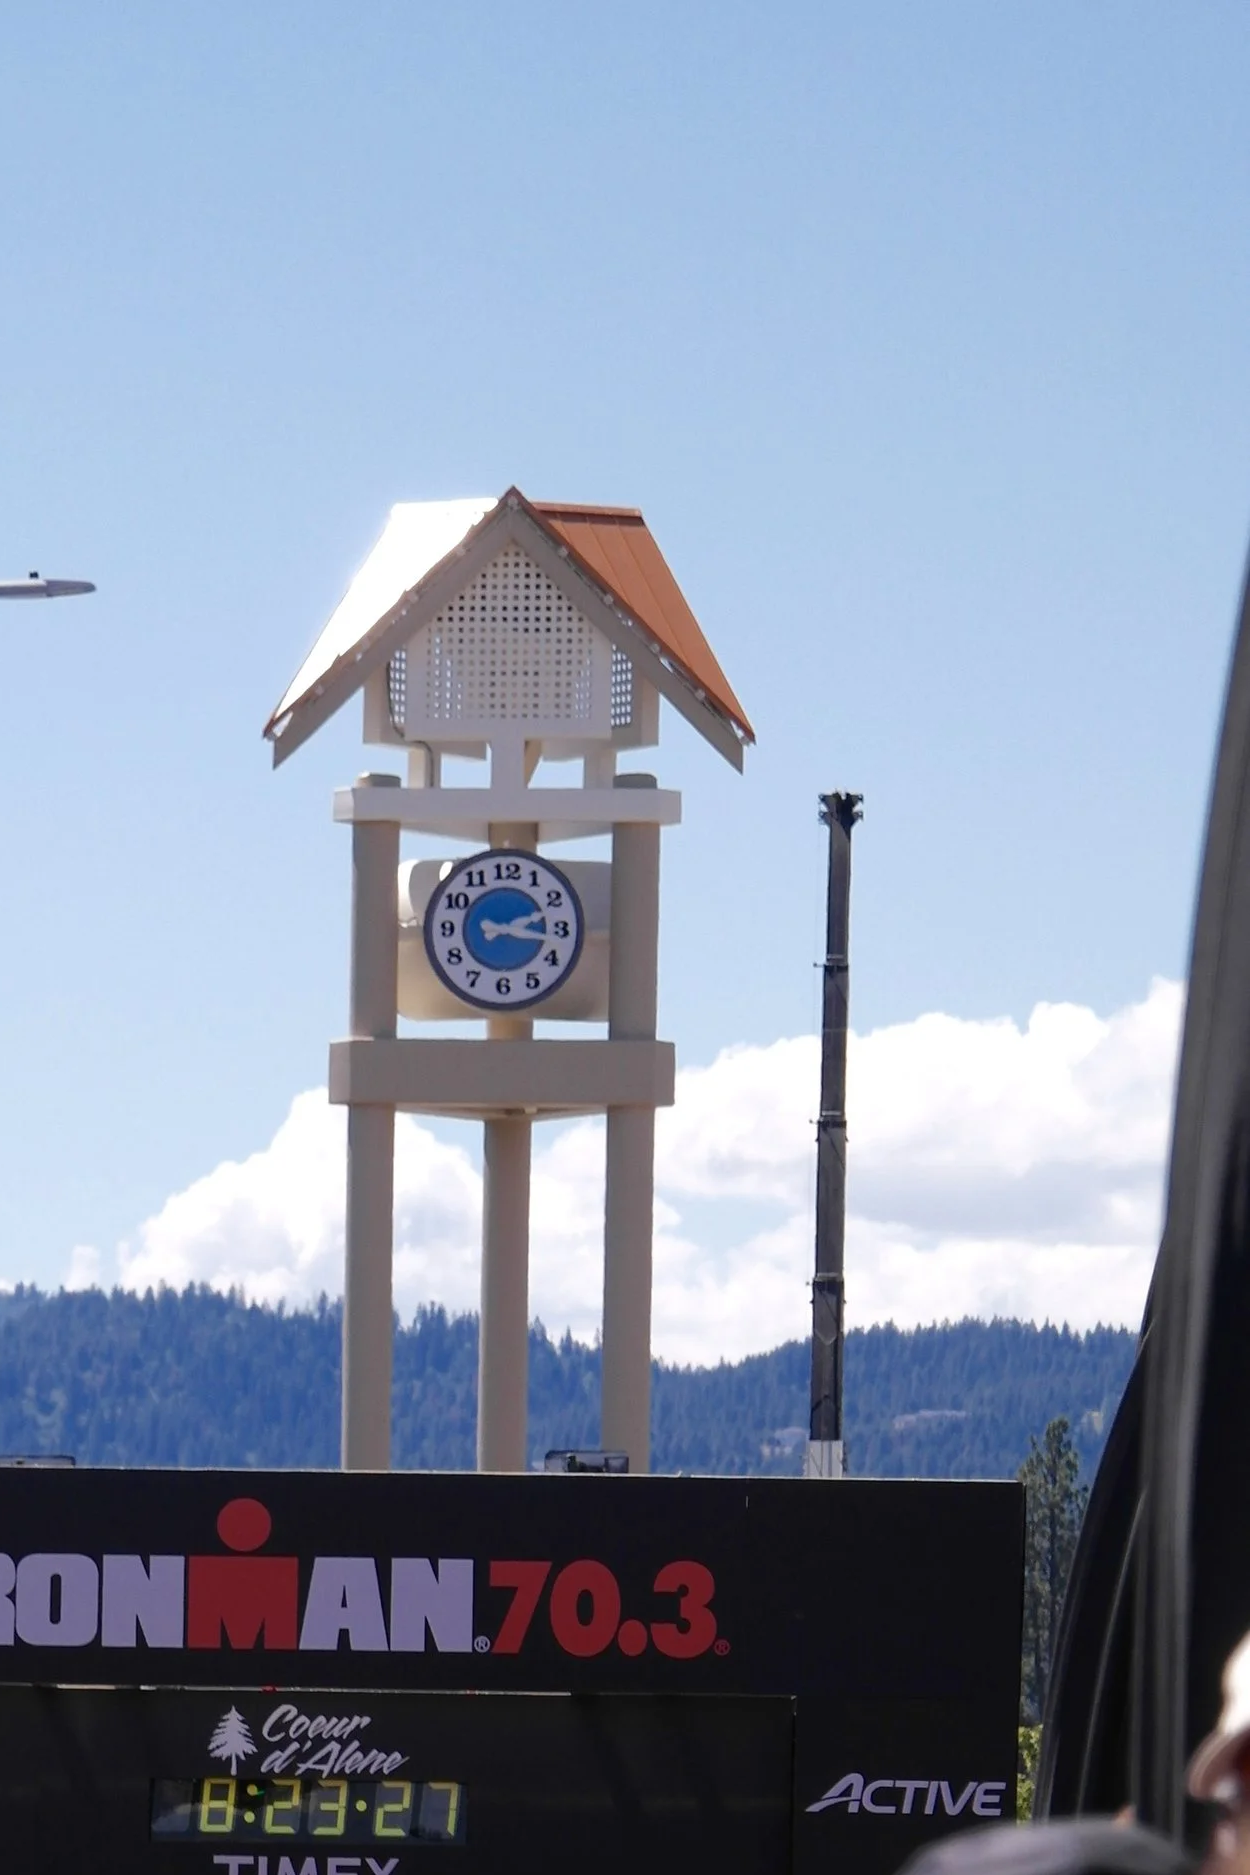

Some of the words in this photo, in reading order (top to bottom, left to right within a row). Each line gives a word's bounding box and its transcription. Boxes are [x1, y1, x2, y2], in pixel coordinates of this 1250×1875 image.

[465, 870, 487, 887] 11
[494, 863, 522, 881] 12
[529, 870, 540, 887] 1
[445, 893, 470, 910] 10
[547, 891, 562, 907] 2
[440, 921, 455, 938] 9
[554, 921, 569, 938] 3
[447, 948, 463, 965] 8
[544, 949, 559, 967] 4
[466, 971, 481, 988] 7
[496, 977, 511, 995] 6
[526, 973, 540, 990] 5
[489, 1559, 718, 1659] 70.3
[262, 1703, 372, 1742] Coeur
[260, 1741, 410, 1778] d'Alene
[805, 1773, 1007, 1816] ACTIVE
